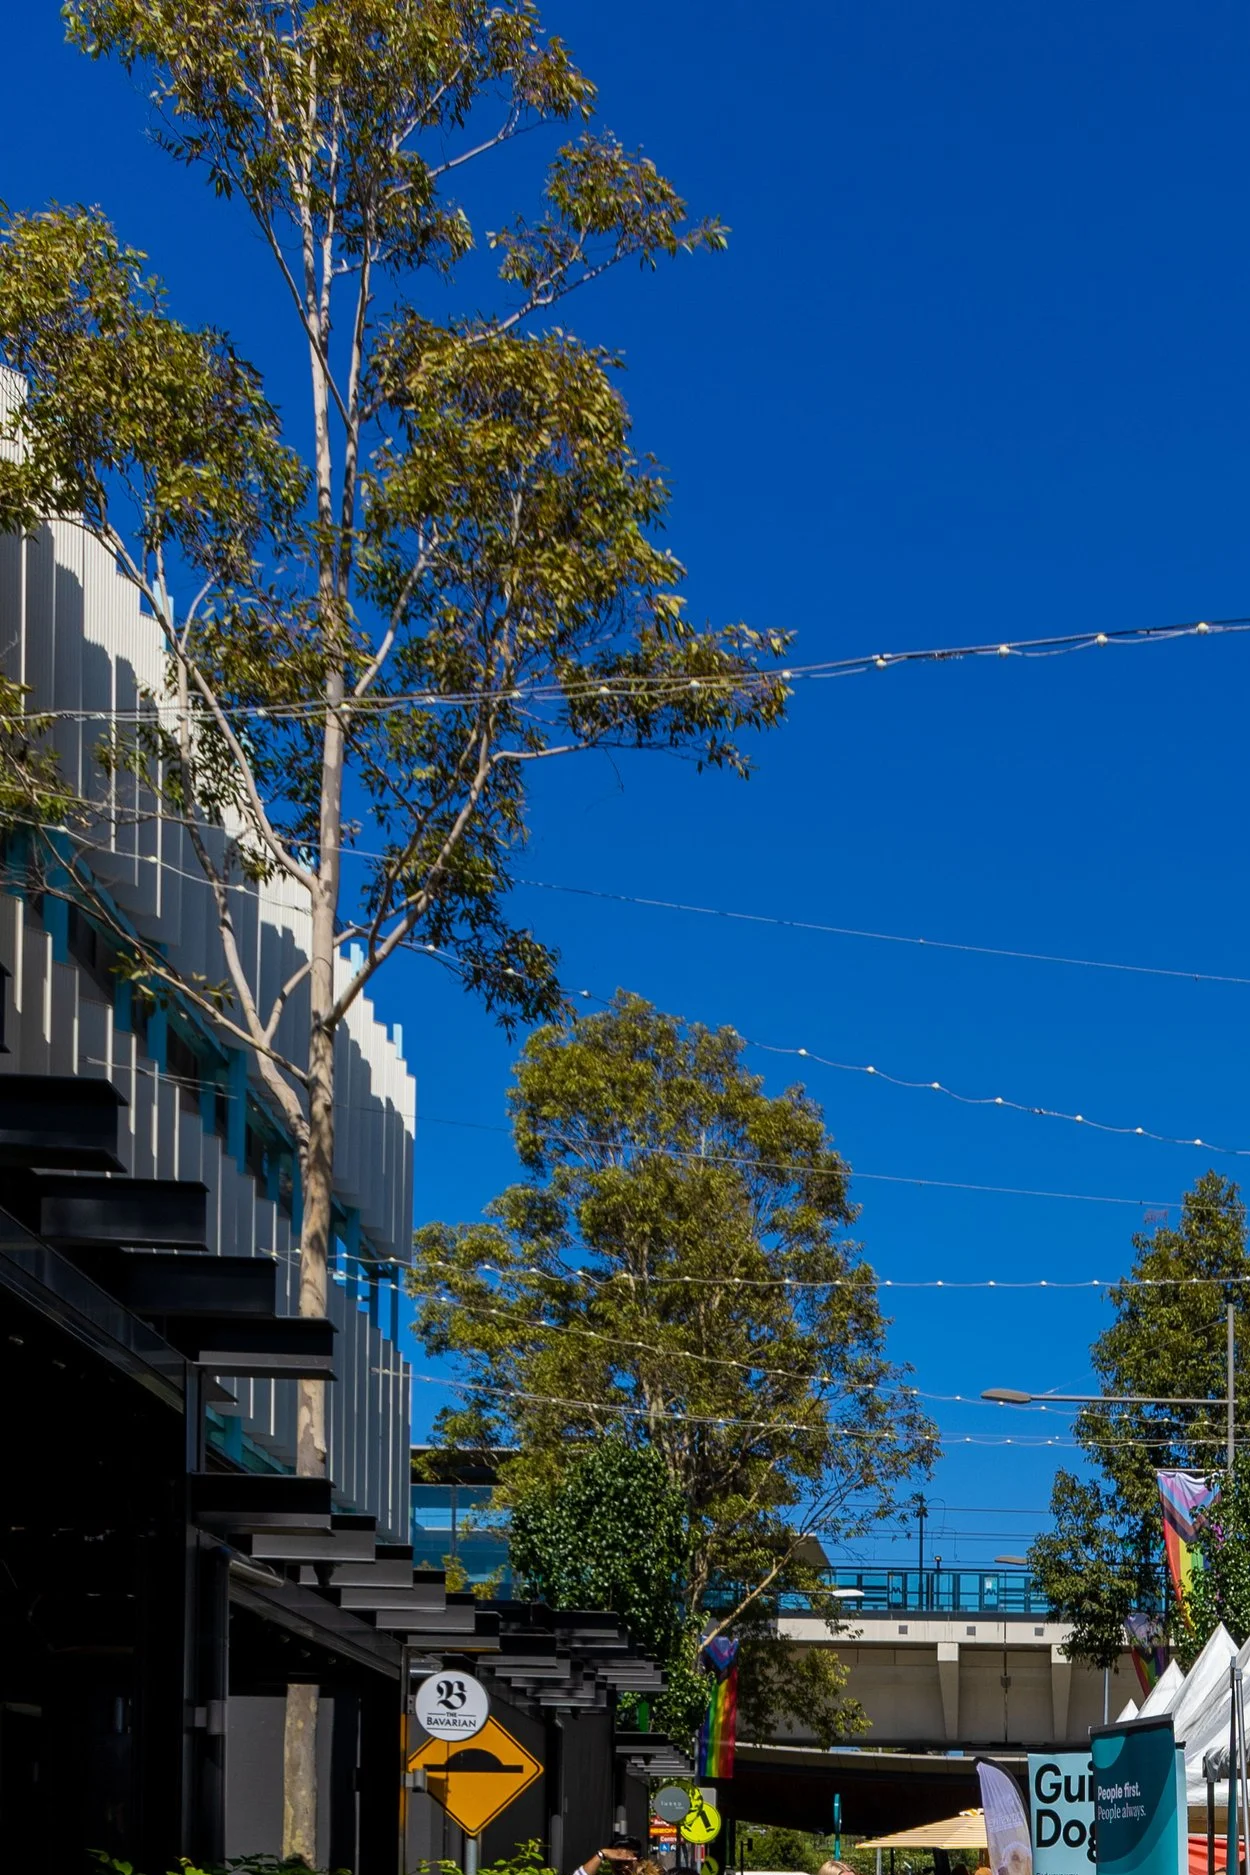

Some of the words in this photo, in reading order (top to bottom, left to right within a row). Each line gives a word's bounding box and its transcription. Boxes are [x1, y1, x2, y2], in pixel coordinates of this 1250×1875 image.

[426, 1717, 476, 1727] BAVARIAN
[1097, 1785, 1123, 1803] People
[1124, 1781, 1141, 1798] first.
[1097, 1803, 1121, 1824] People
[1121, 1802, 1146, 1821] always.
